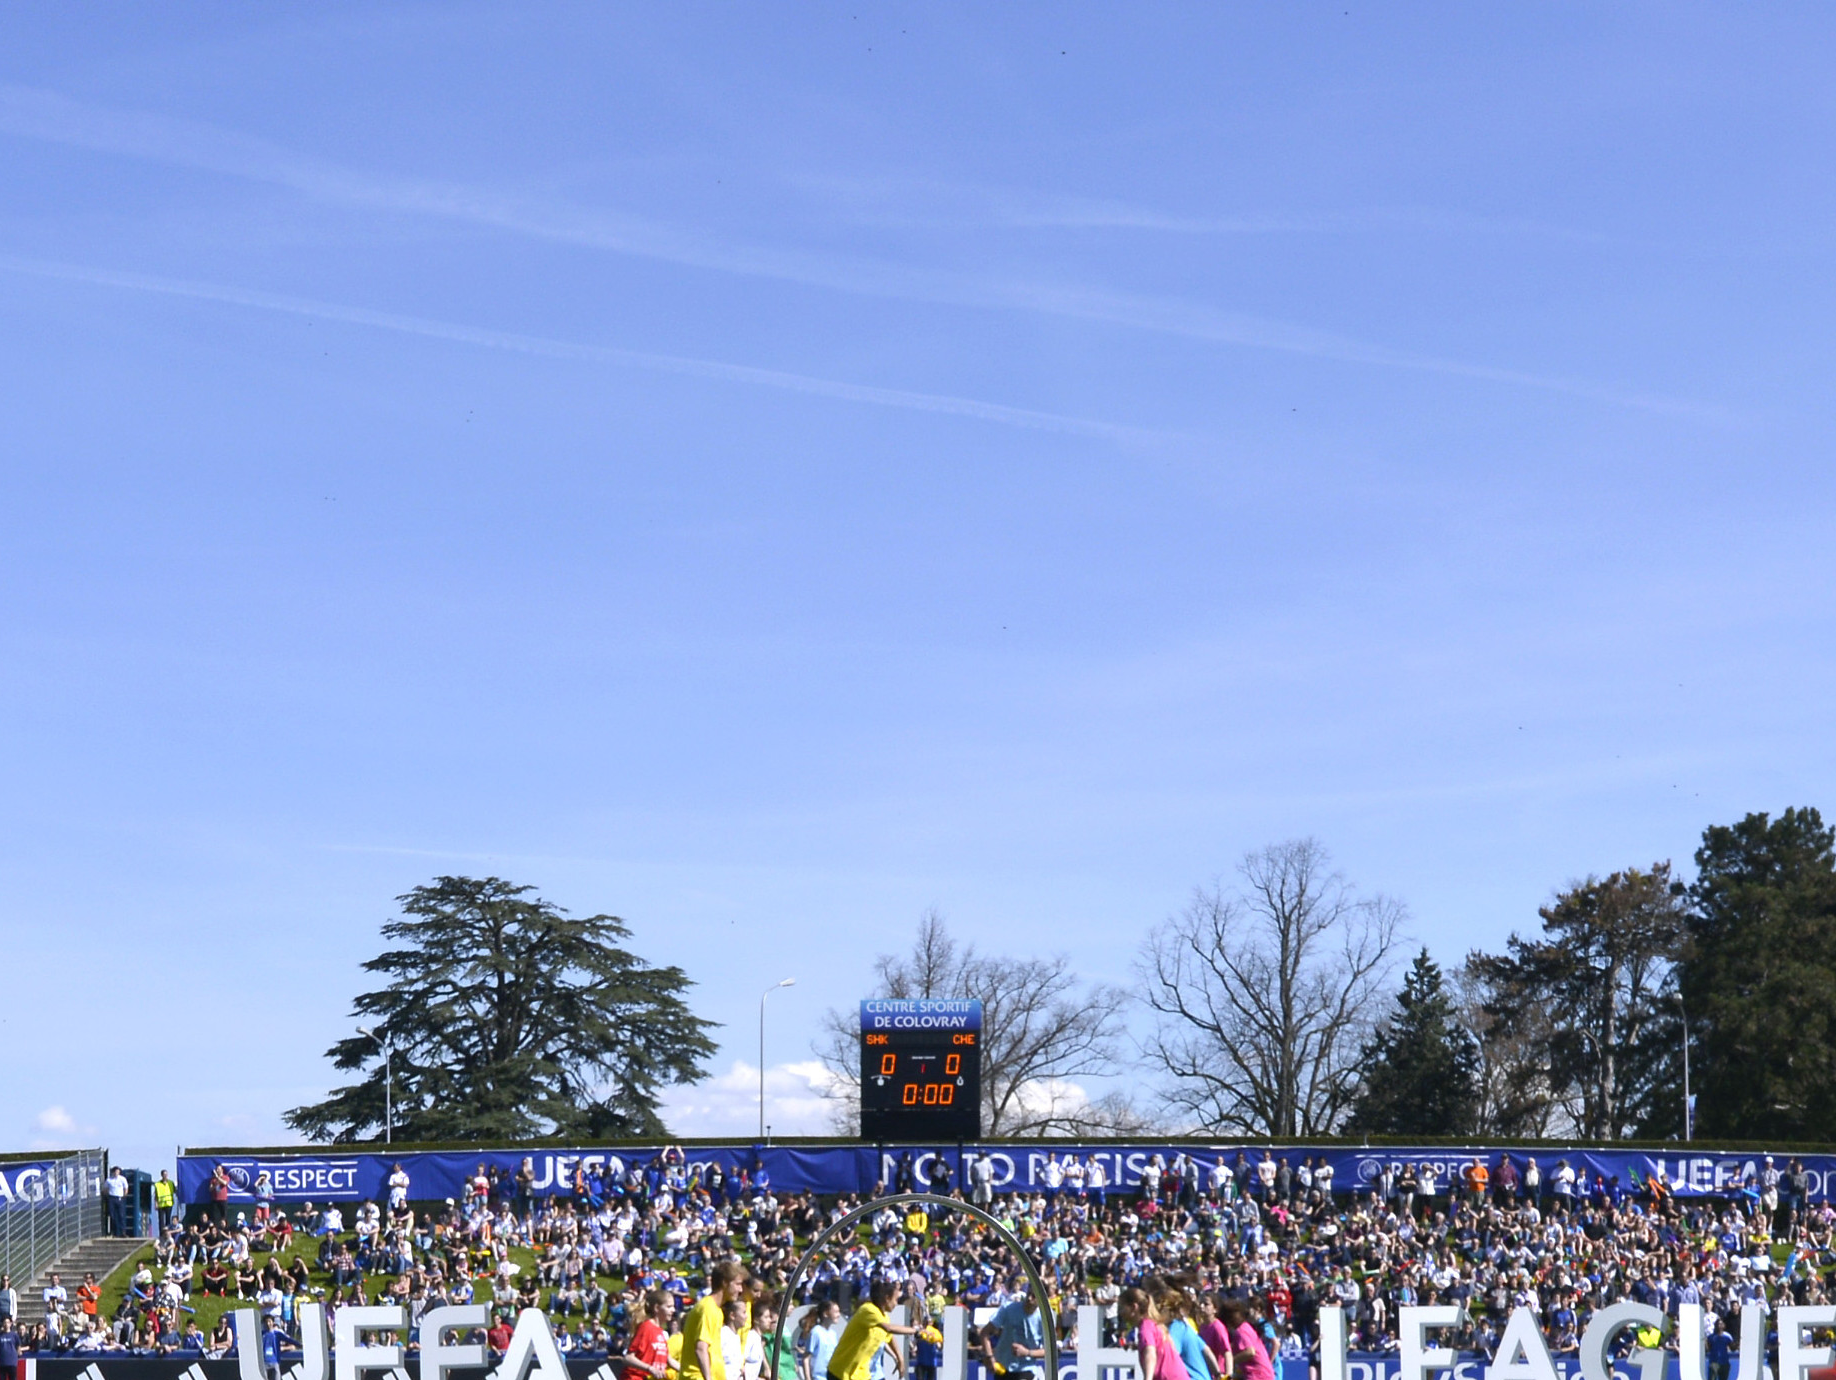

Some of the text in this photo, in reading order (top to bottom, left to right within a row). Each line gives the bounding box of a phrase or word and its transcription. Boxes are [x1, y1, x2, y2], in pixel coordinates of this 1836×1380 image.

[866, 1001, 972, 1013] CENTRE SPORTIF
[874, 1016, 967, 1028] DE COLOVRAY
[866, 1034, 975, 1045] SHK CHE
[881, 1054, 960, 1075] 0 0
[903, 1084, 954, 1105] 0:00
[258, 1168, 358, 1190] RESPECT
